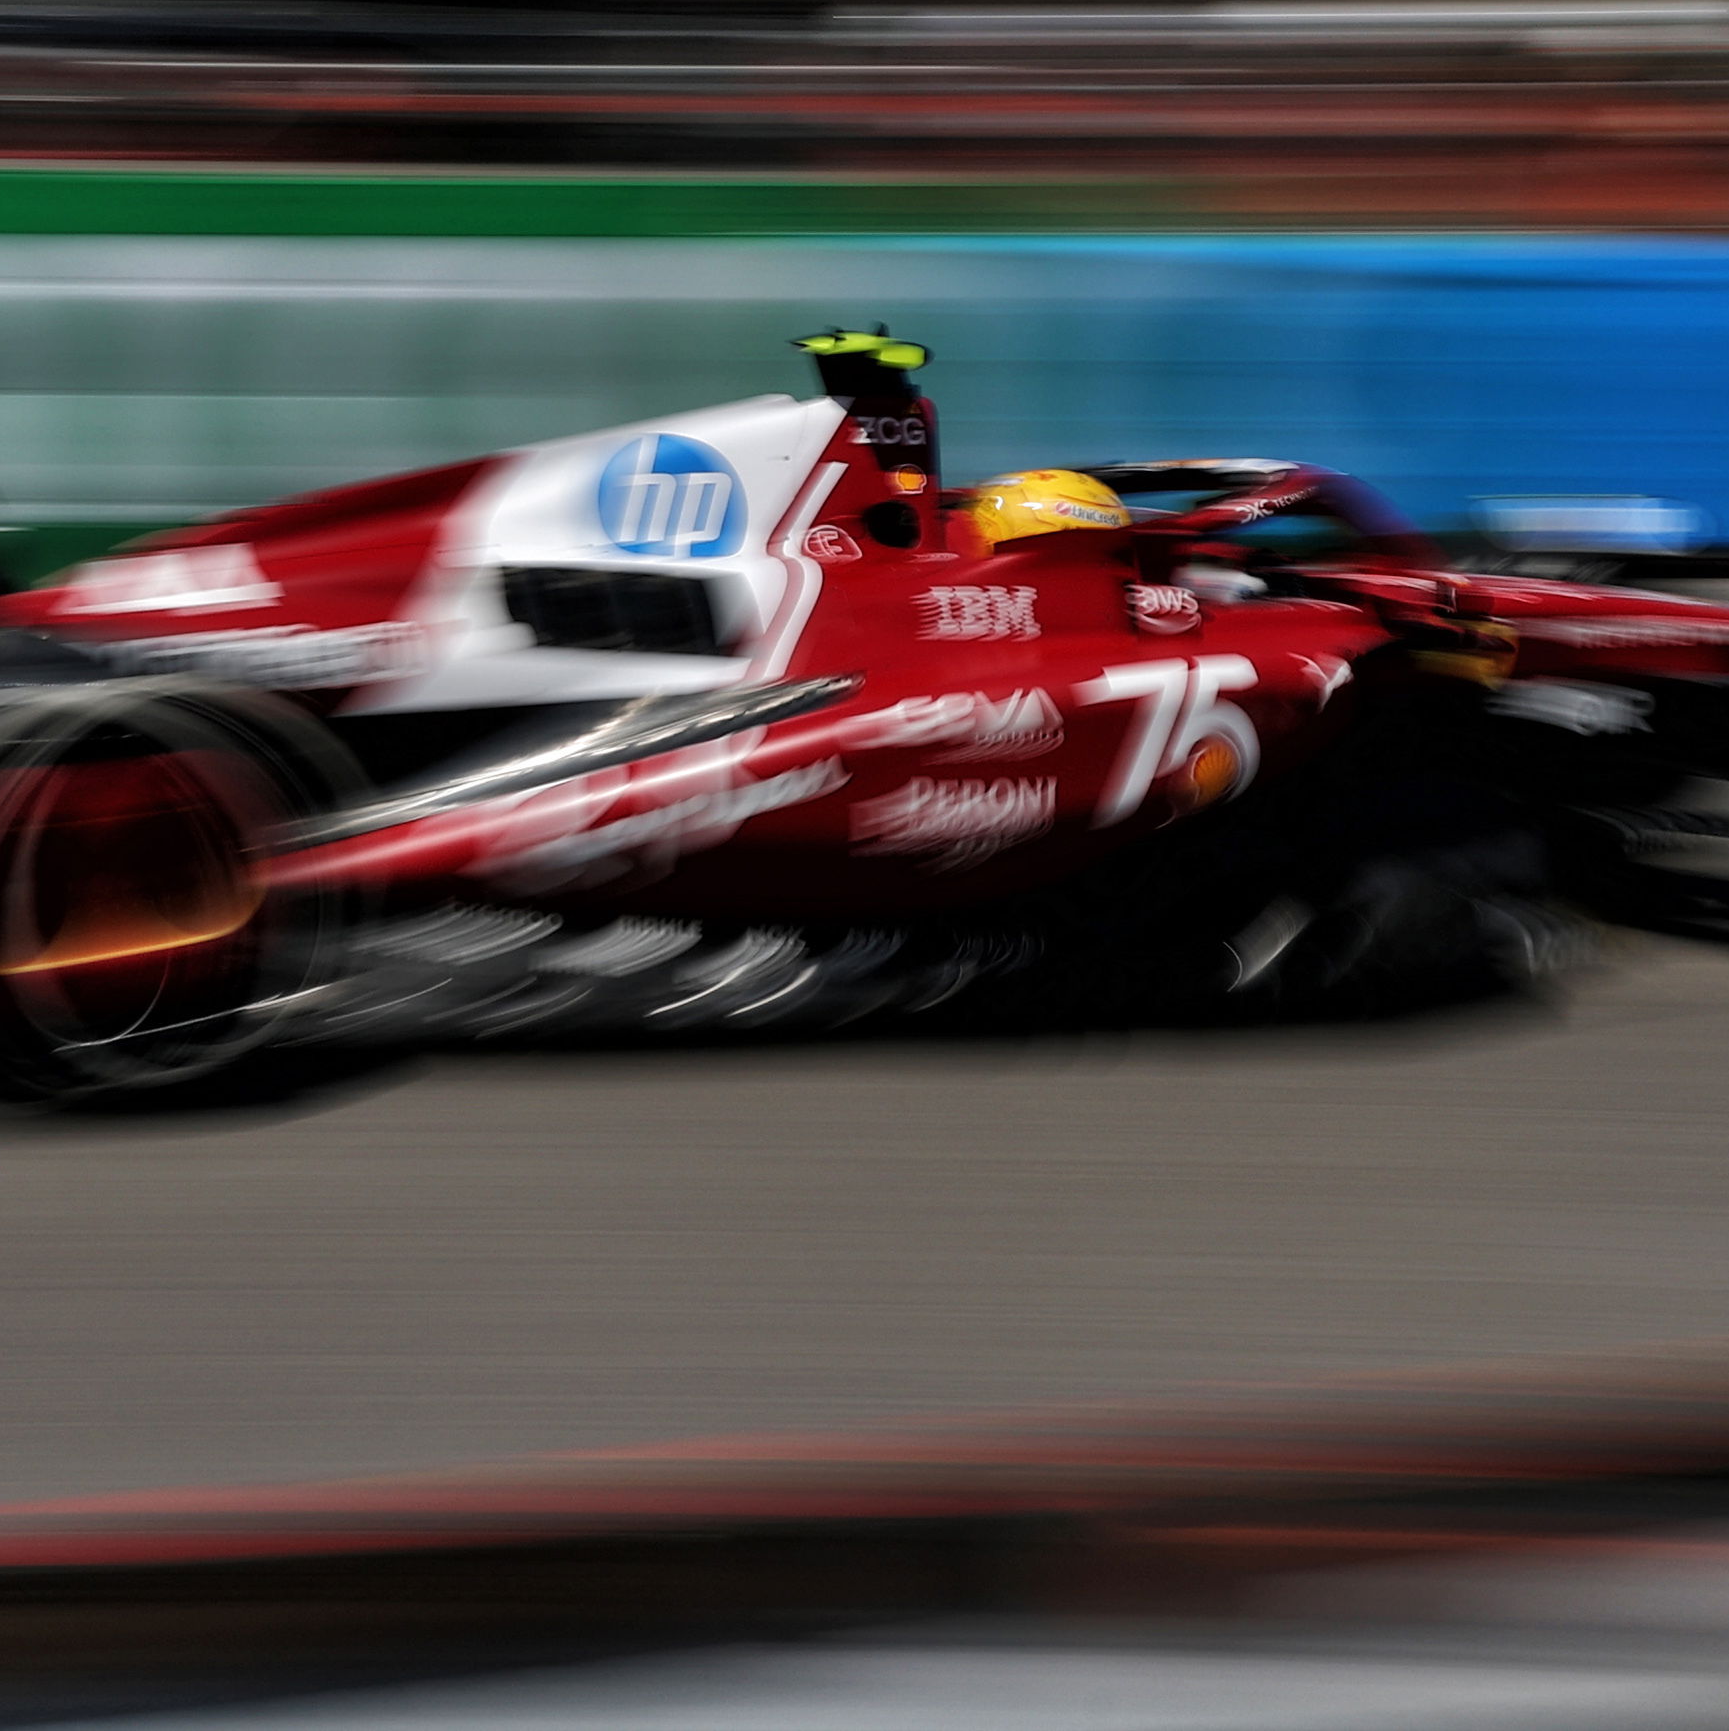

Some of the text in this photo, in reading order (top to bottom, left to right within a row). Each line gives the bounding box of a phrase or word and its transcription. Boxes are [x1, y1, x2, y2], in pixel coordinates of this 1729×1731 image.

[618, 435, 733, 557] hp
[912, 585, 1041, 641] IBM
[1069, 653, 1261, 831] 75
